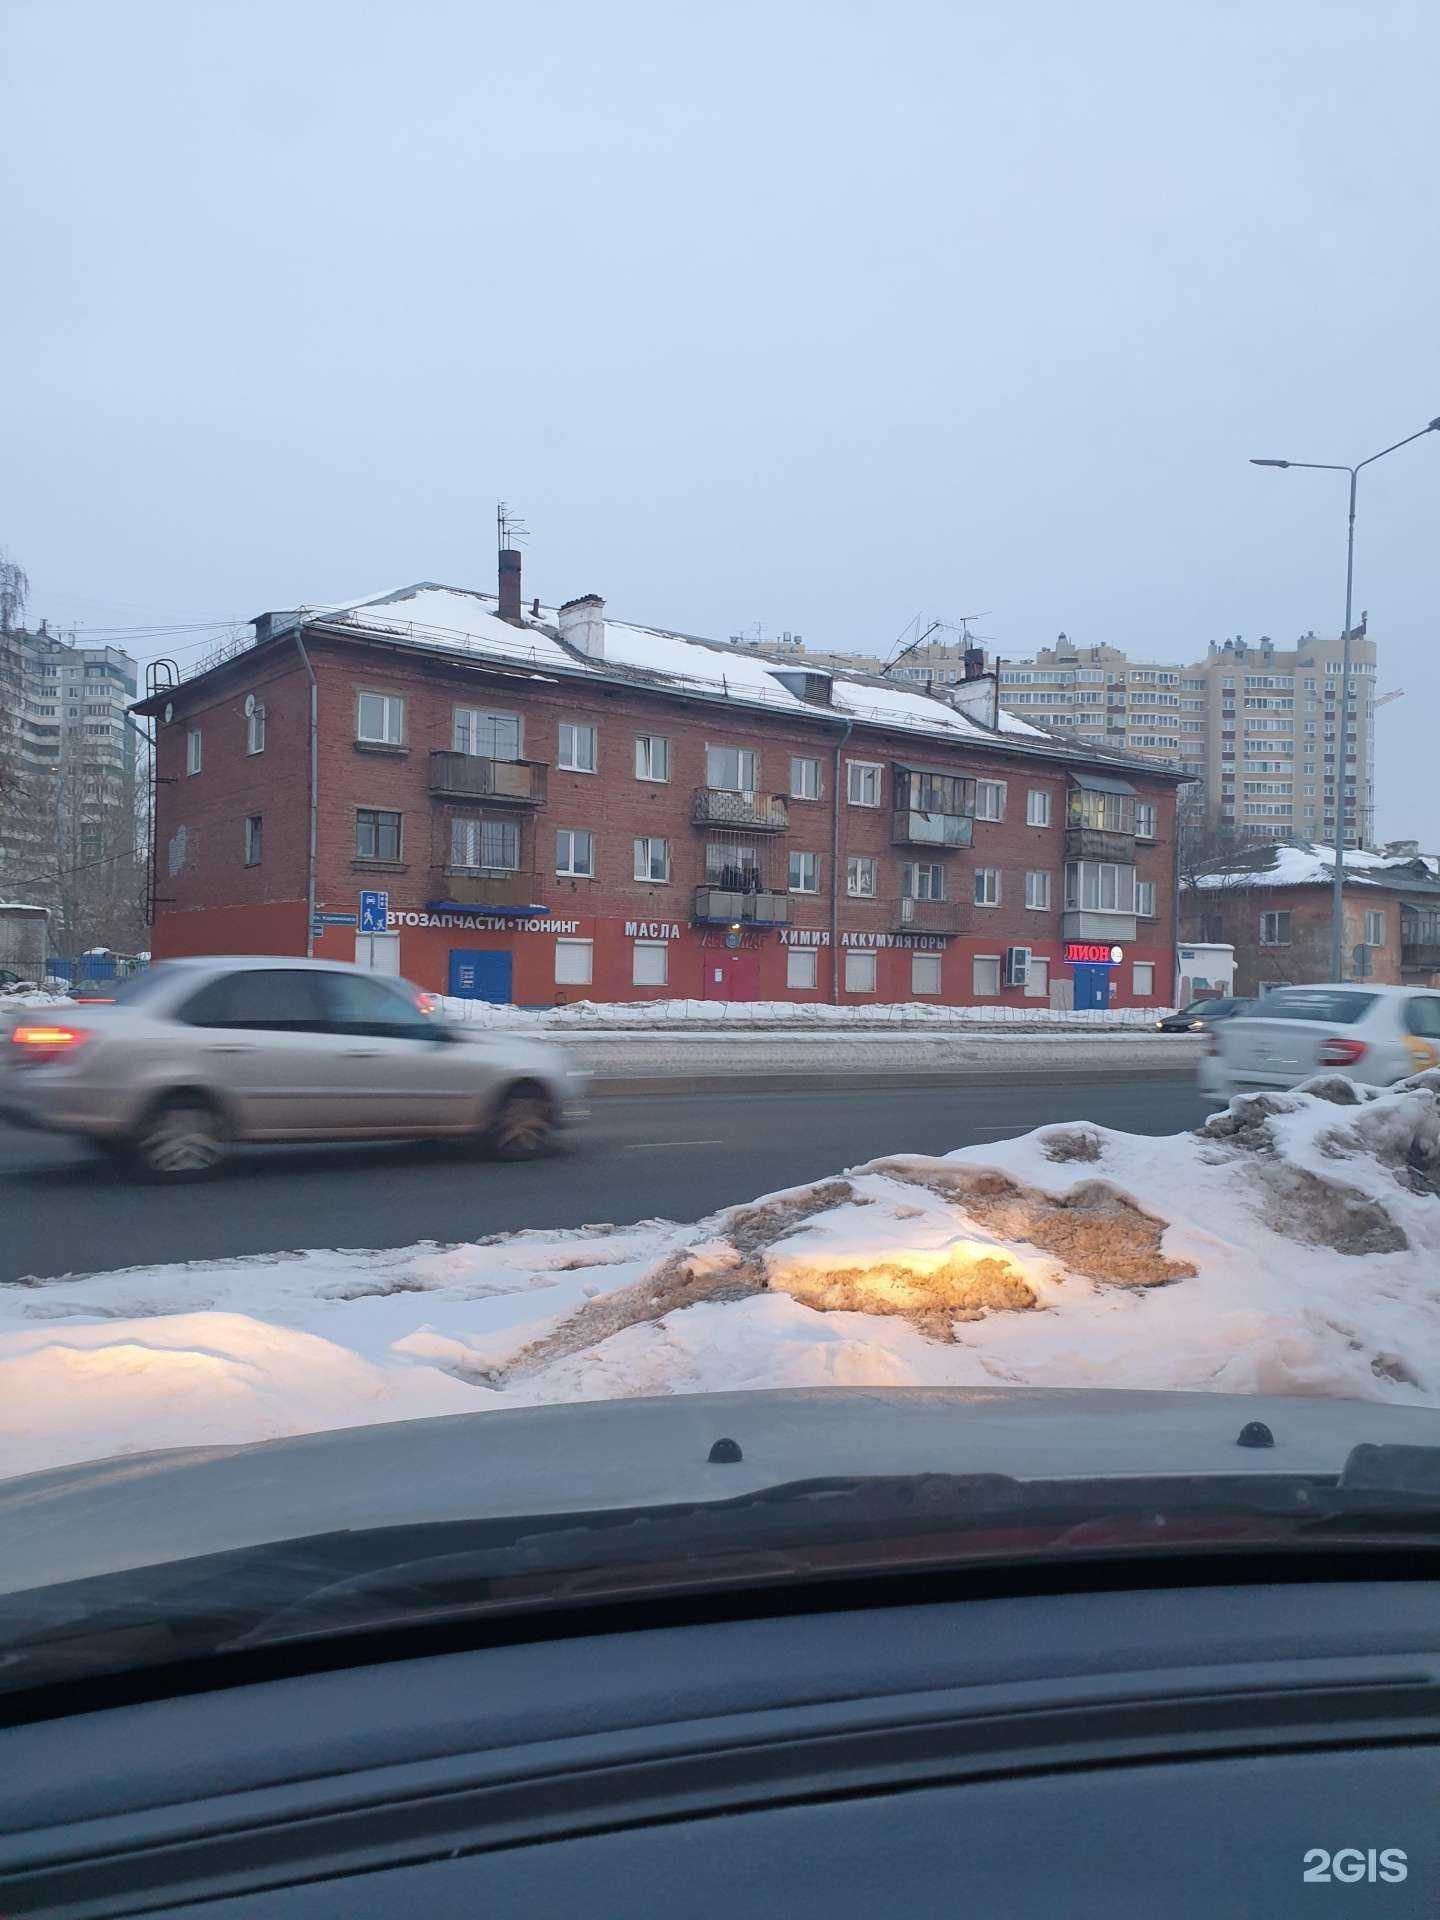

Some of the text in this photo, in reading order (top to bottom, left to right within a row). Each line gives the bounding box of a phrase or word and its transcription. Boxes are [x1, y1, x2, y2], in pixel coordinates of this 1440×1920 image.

[387, 912, 505, 931] ВТОЗАПЧАСТИ
[625, 921, 680, 939] МАСЛА
[780, 930, 947, 950] ХИМИЯ АККУМУЛЯТОРЫ
